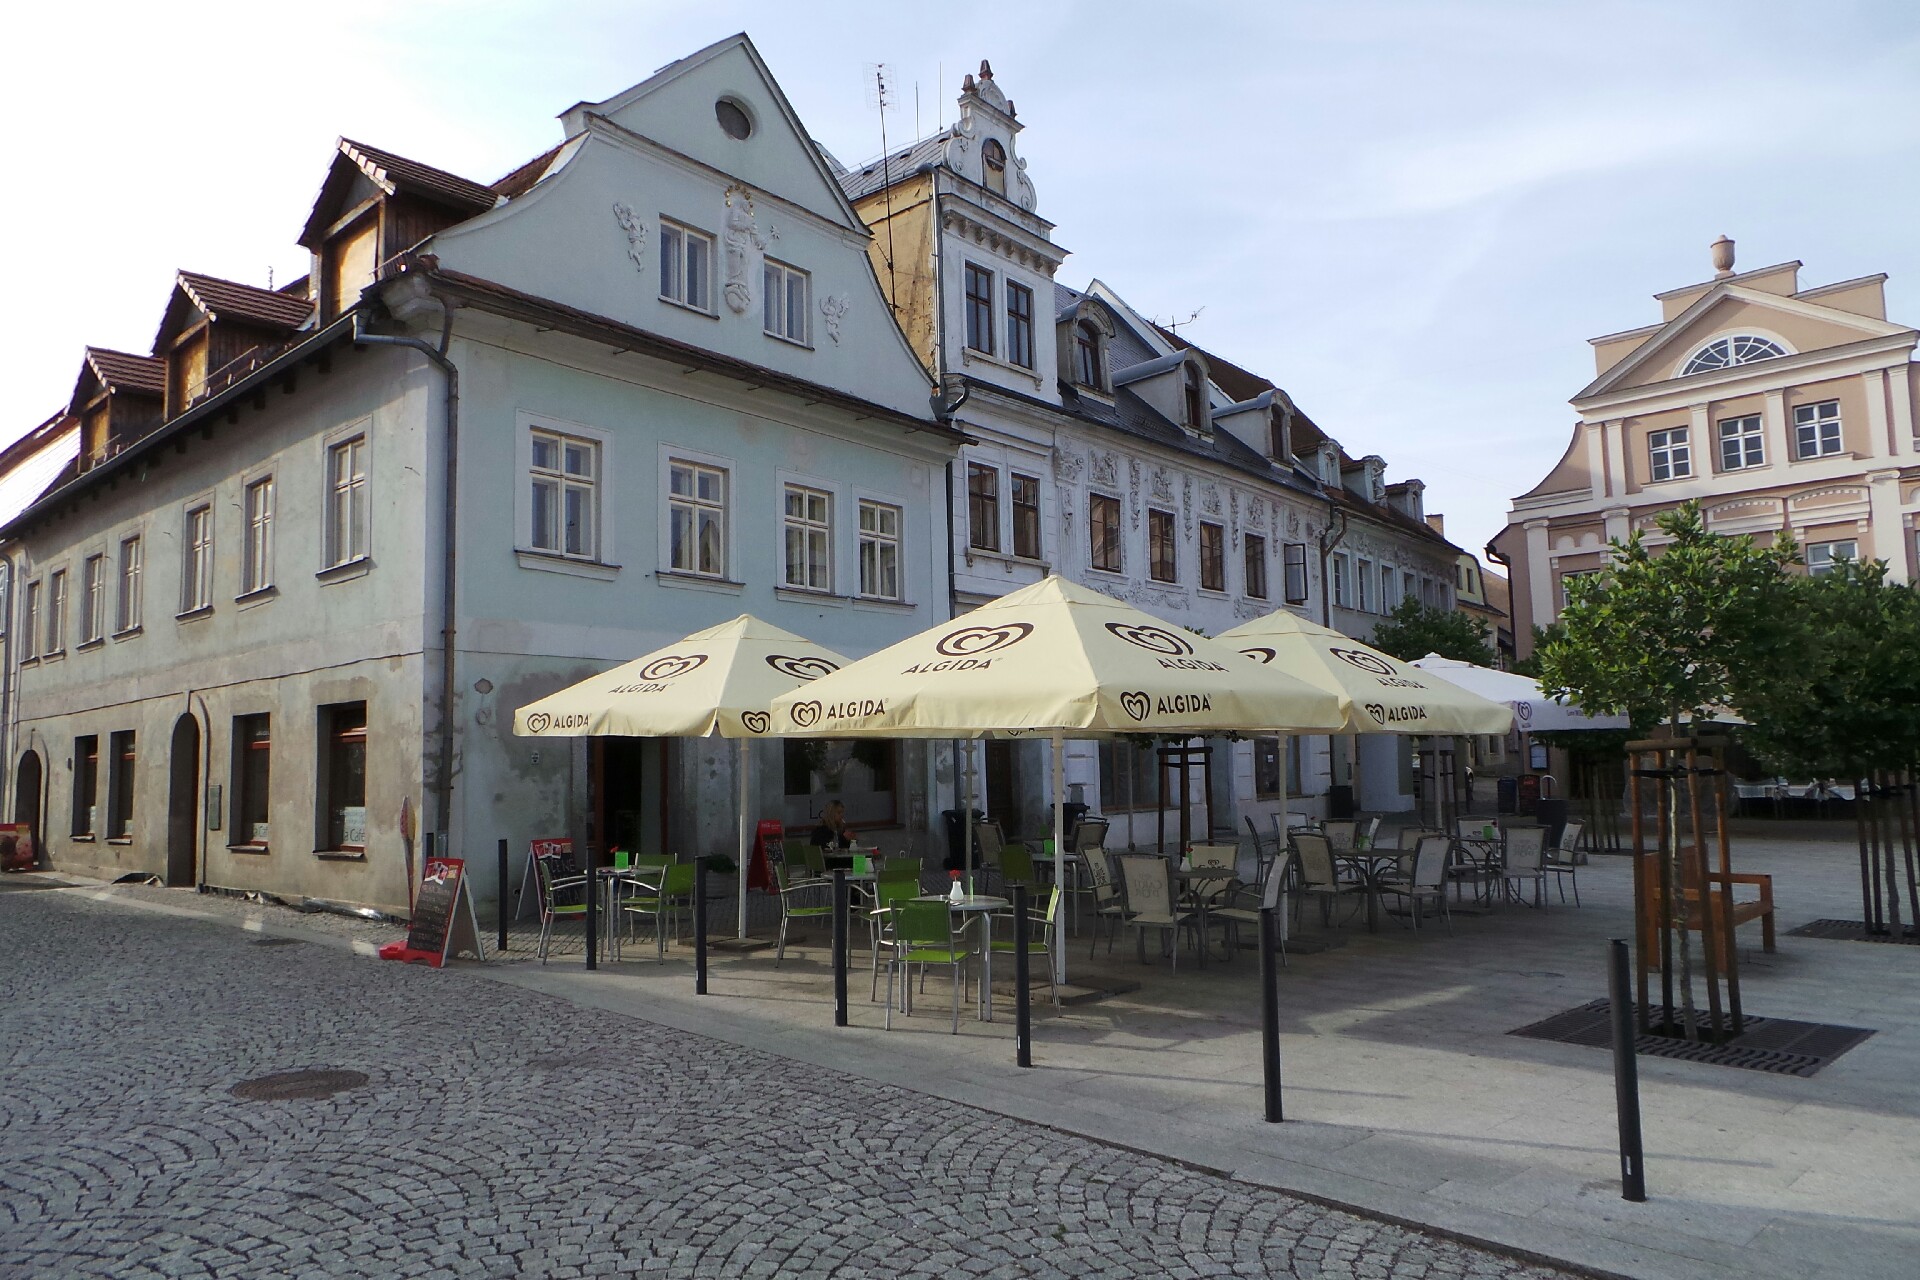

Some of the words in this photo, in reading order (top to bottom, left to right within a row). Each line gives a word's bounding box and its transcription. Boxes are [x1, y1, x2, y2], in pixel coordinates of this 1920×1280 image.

[901, 658, 992, 675] ALGIDA
[1156, 657, 1230, 673] ALGIDA
[608, 683, 668, 694] ALGIDA
[826, 698, 886, 720] ALGIDA
[1157, 694, 1212, 715] ALGIDA
[553, 714, 589, 729] ALGIDA
[1388, 705, 1428, 722] ALGIDA
